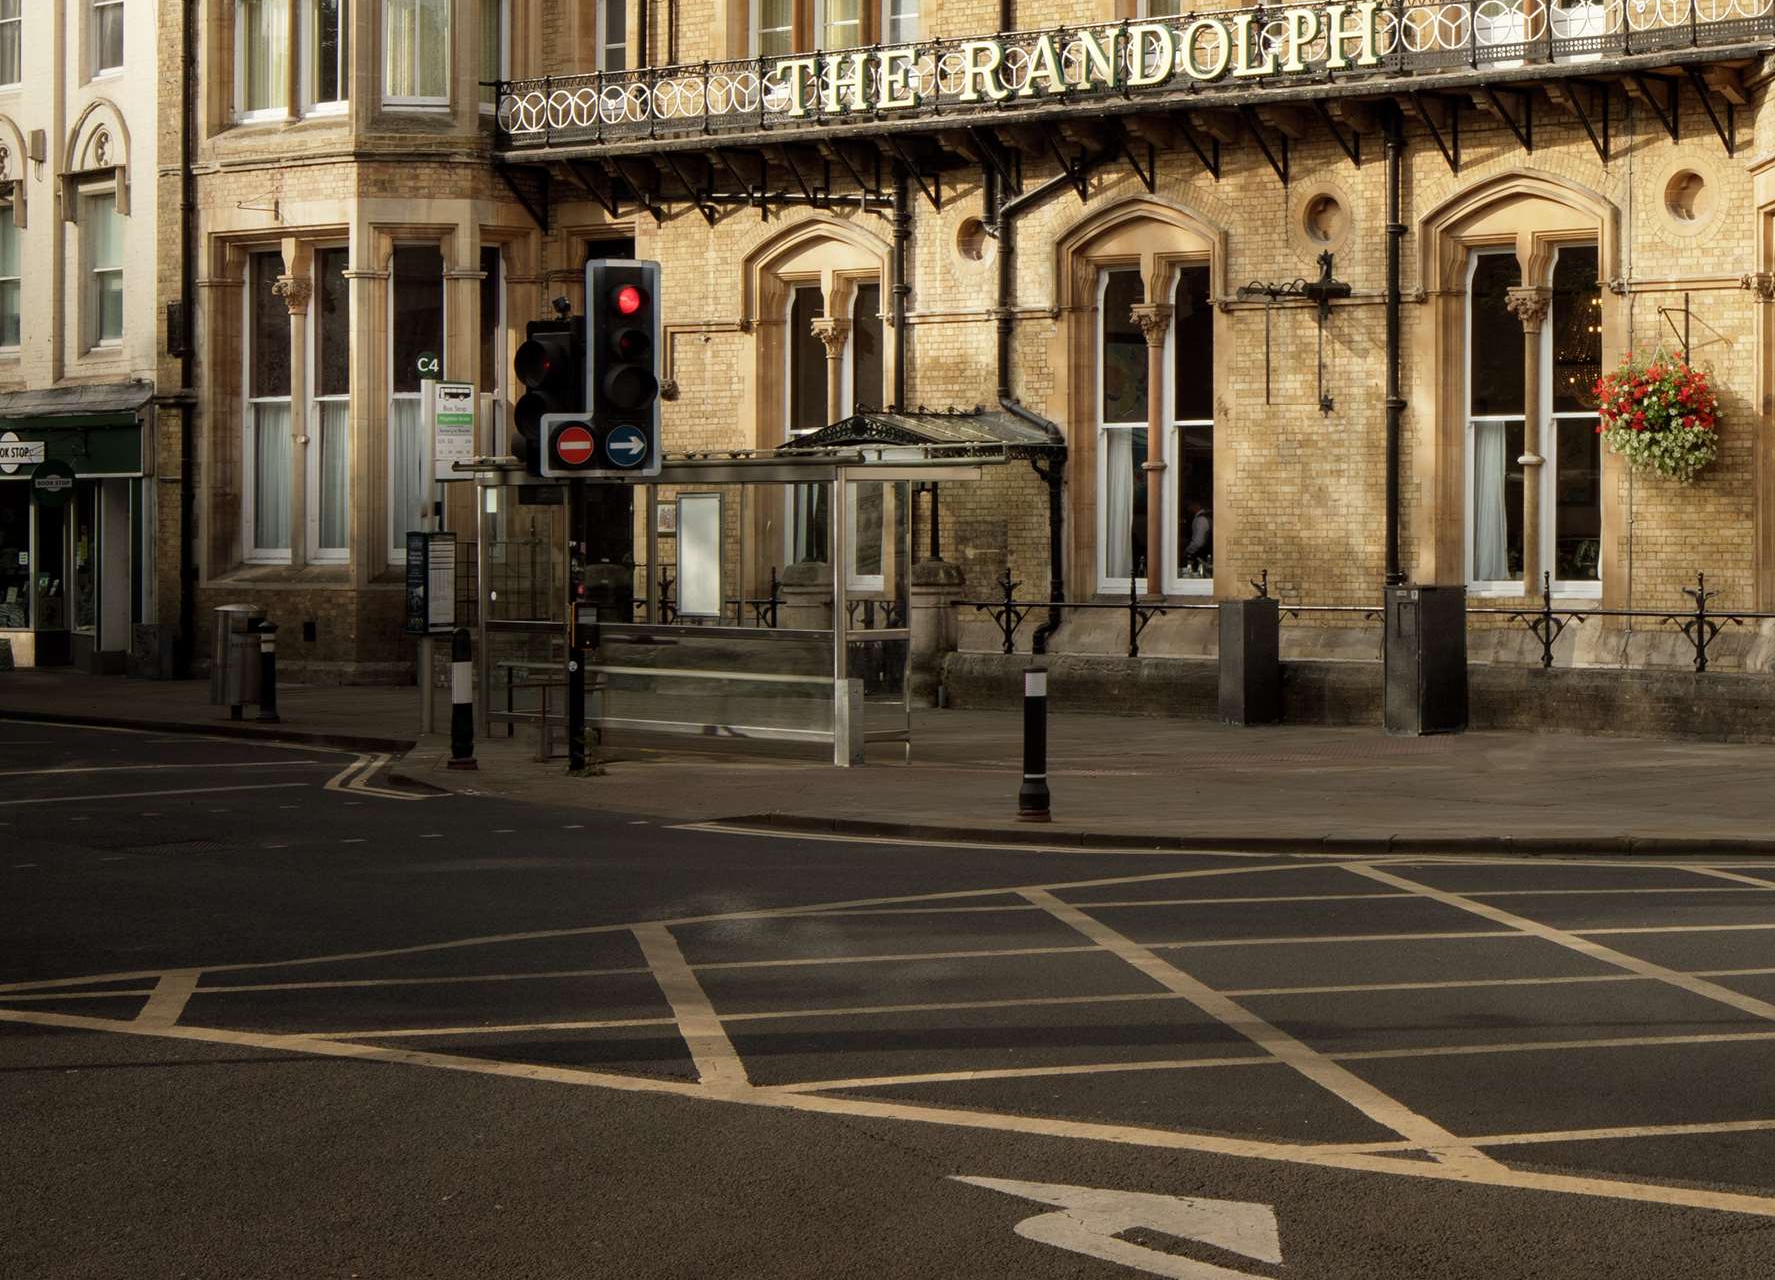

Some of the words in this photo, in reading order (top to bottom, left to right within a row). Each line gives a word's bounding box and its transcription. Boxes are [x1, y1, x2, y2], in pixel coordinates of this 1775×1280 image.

[776, 49, 918, 116] THE
[959, 1, 1383, 102] RANDOLPH
[417, 357, 439, 372] C4
[0, 447, 9, 458] OK
[11, 447, 29, 458] STOP
